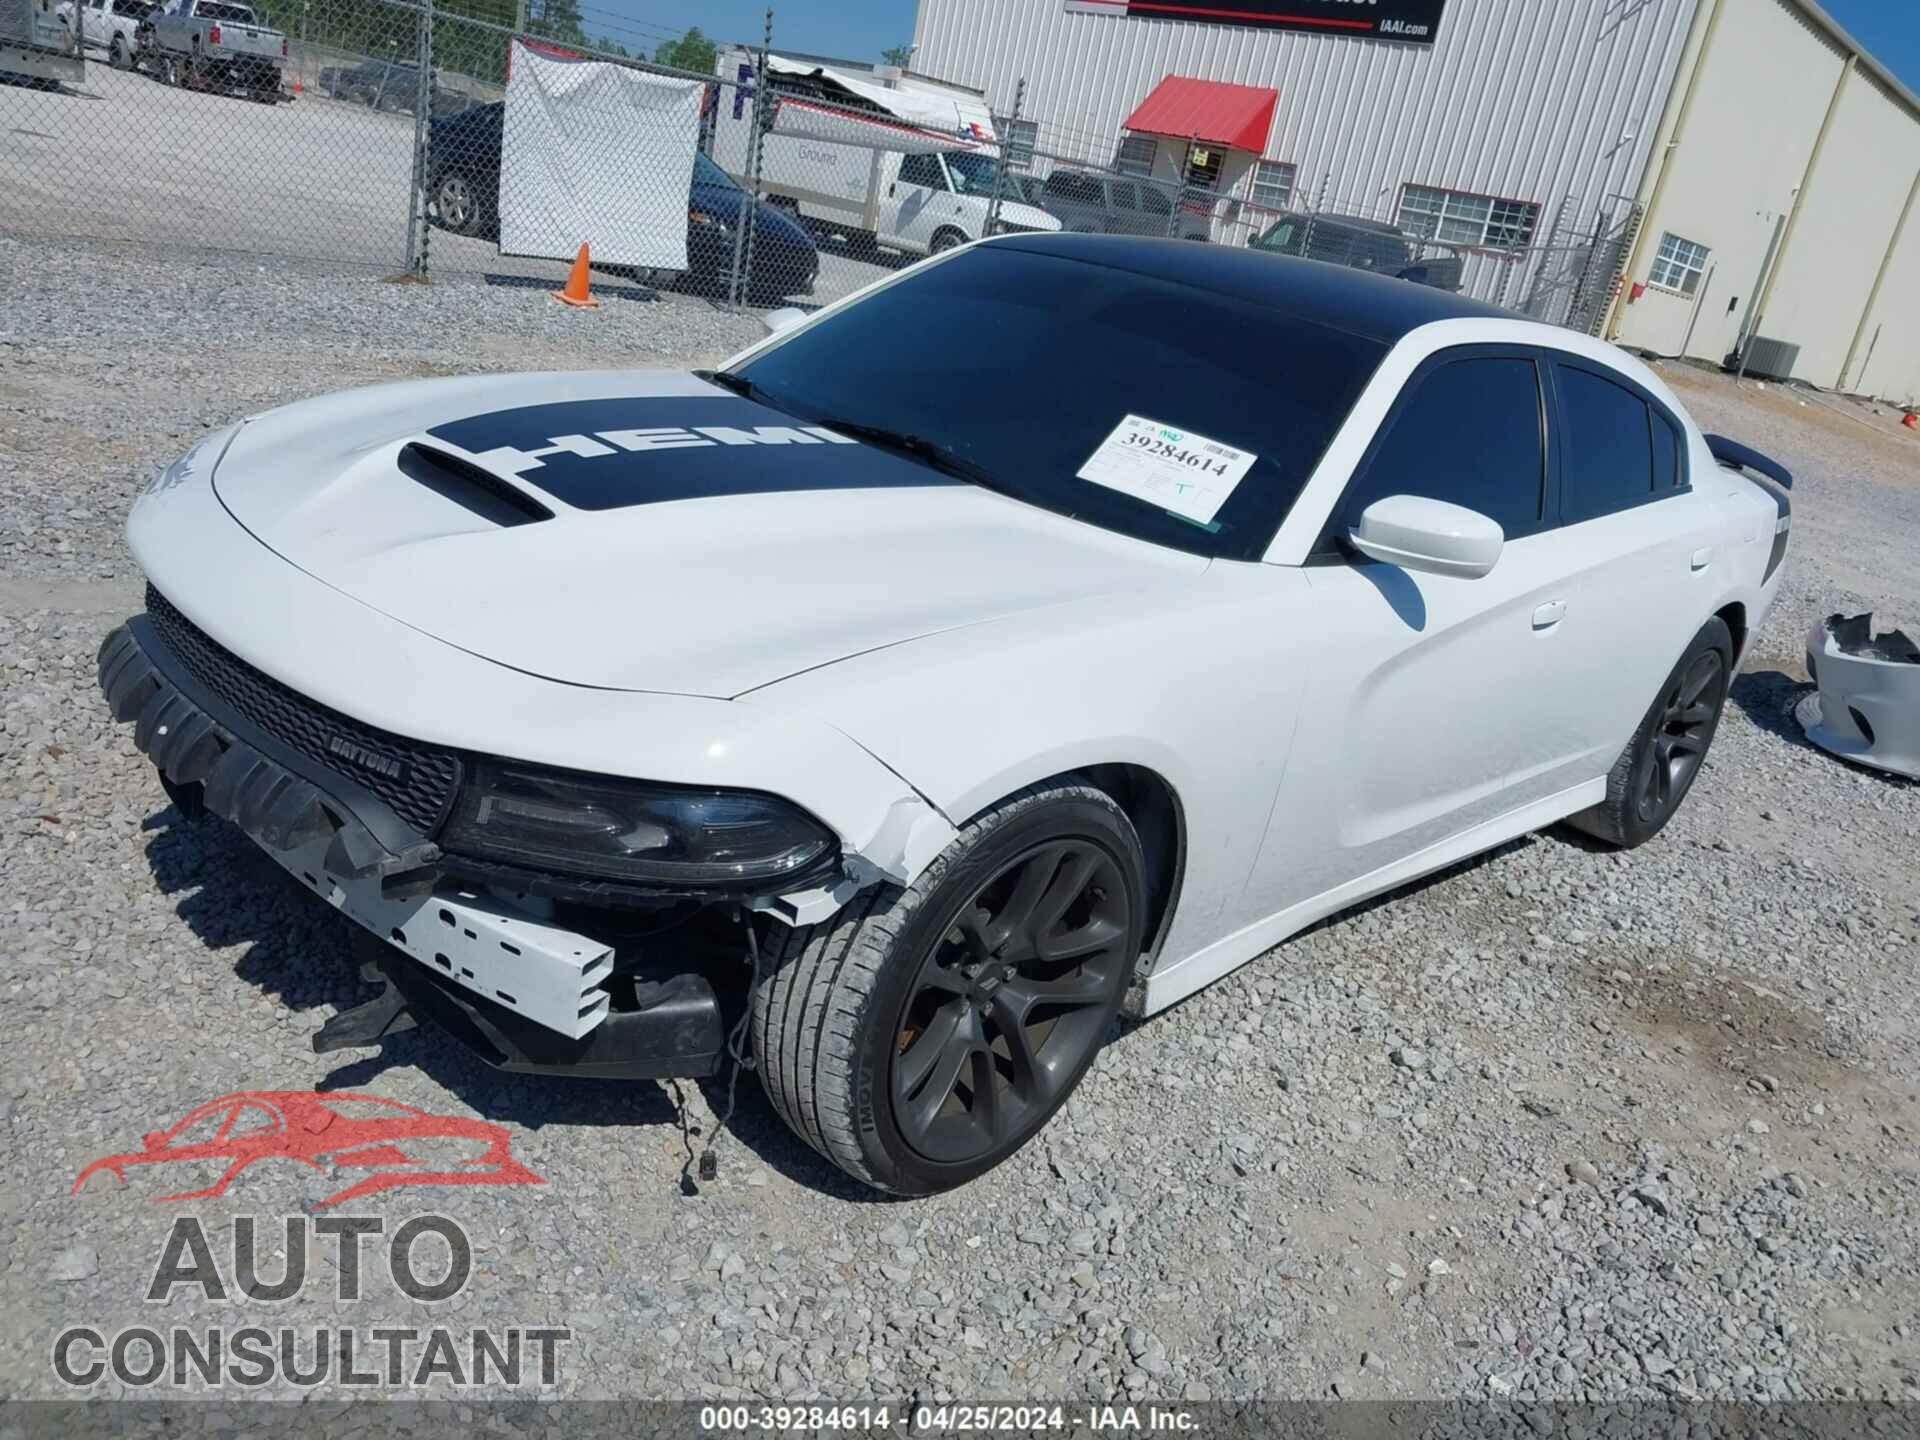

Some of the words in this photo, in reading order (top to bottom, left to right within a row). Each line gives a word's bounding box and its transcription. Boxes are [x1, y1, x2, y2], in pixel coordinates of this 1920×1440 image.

[1379, 19, 1428, 35] IAAI.com
[475, 426, 861, 475] HEMI
[1122, 433, 1228, 476] 39284614
